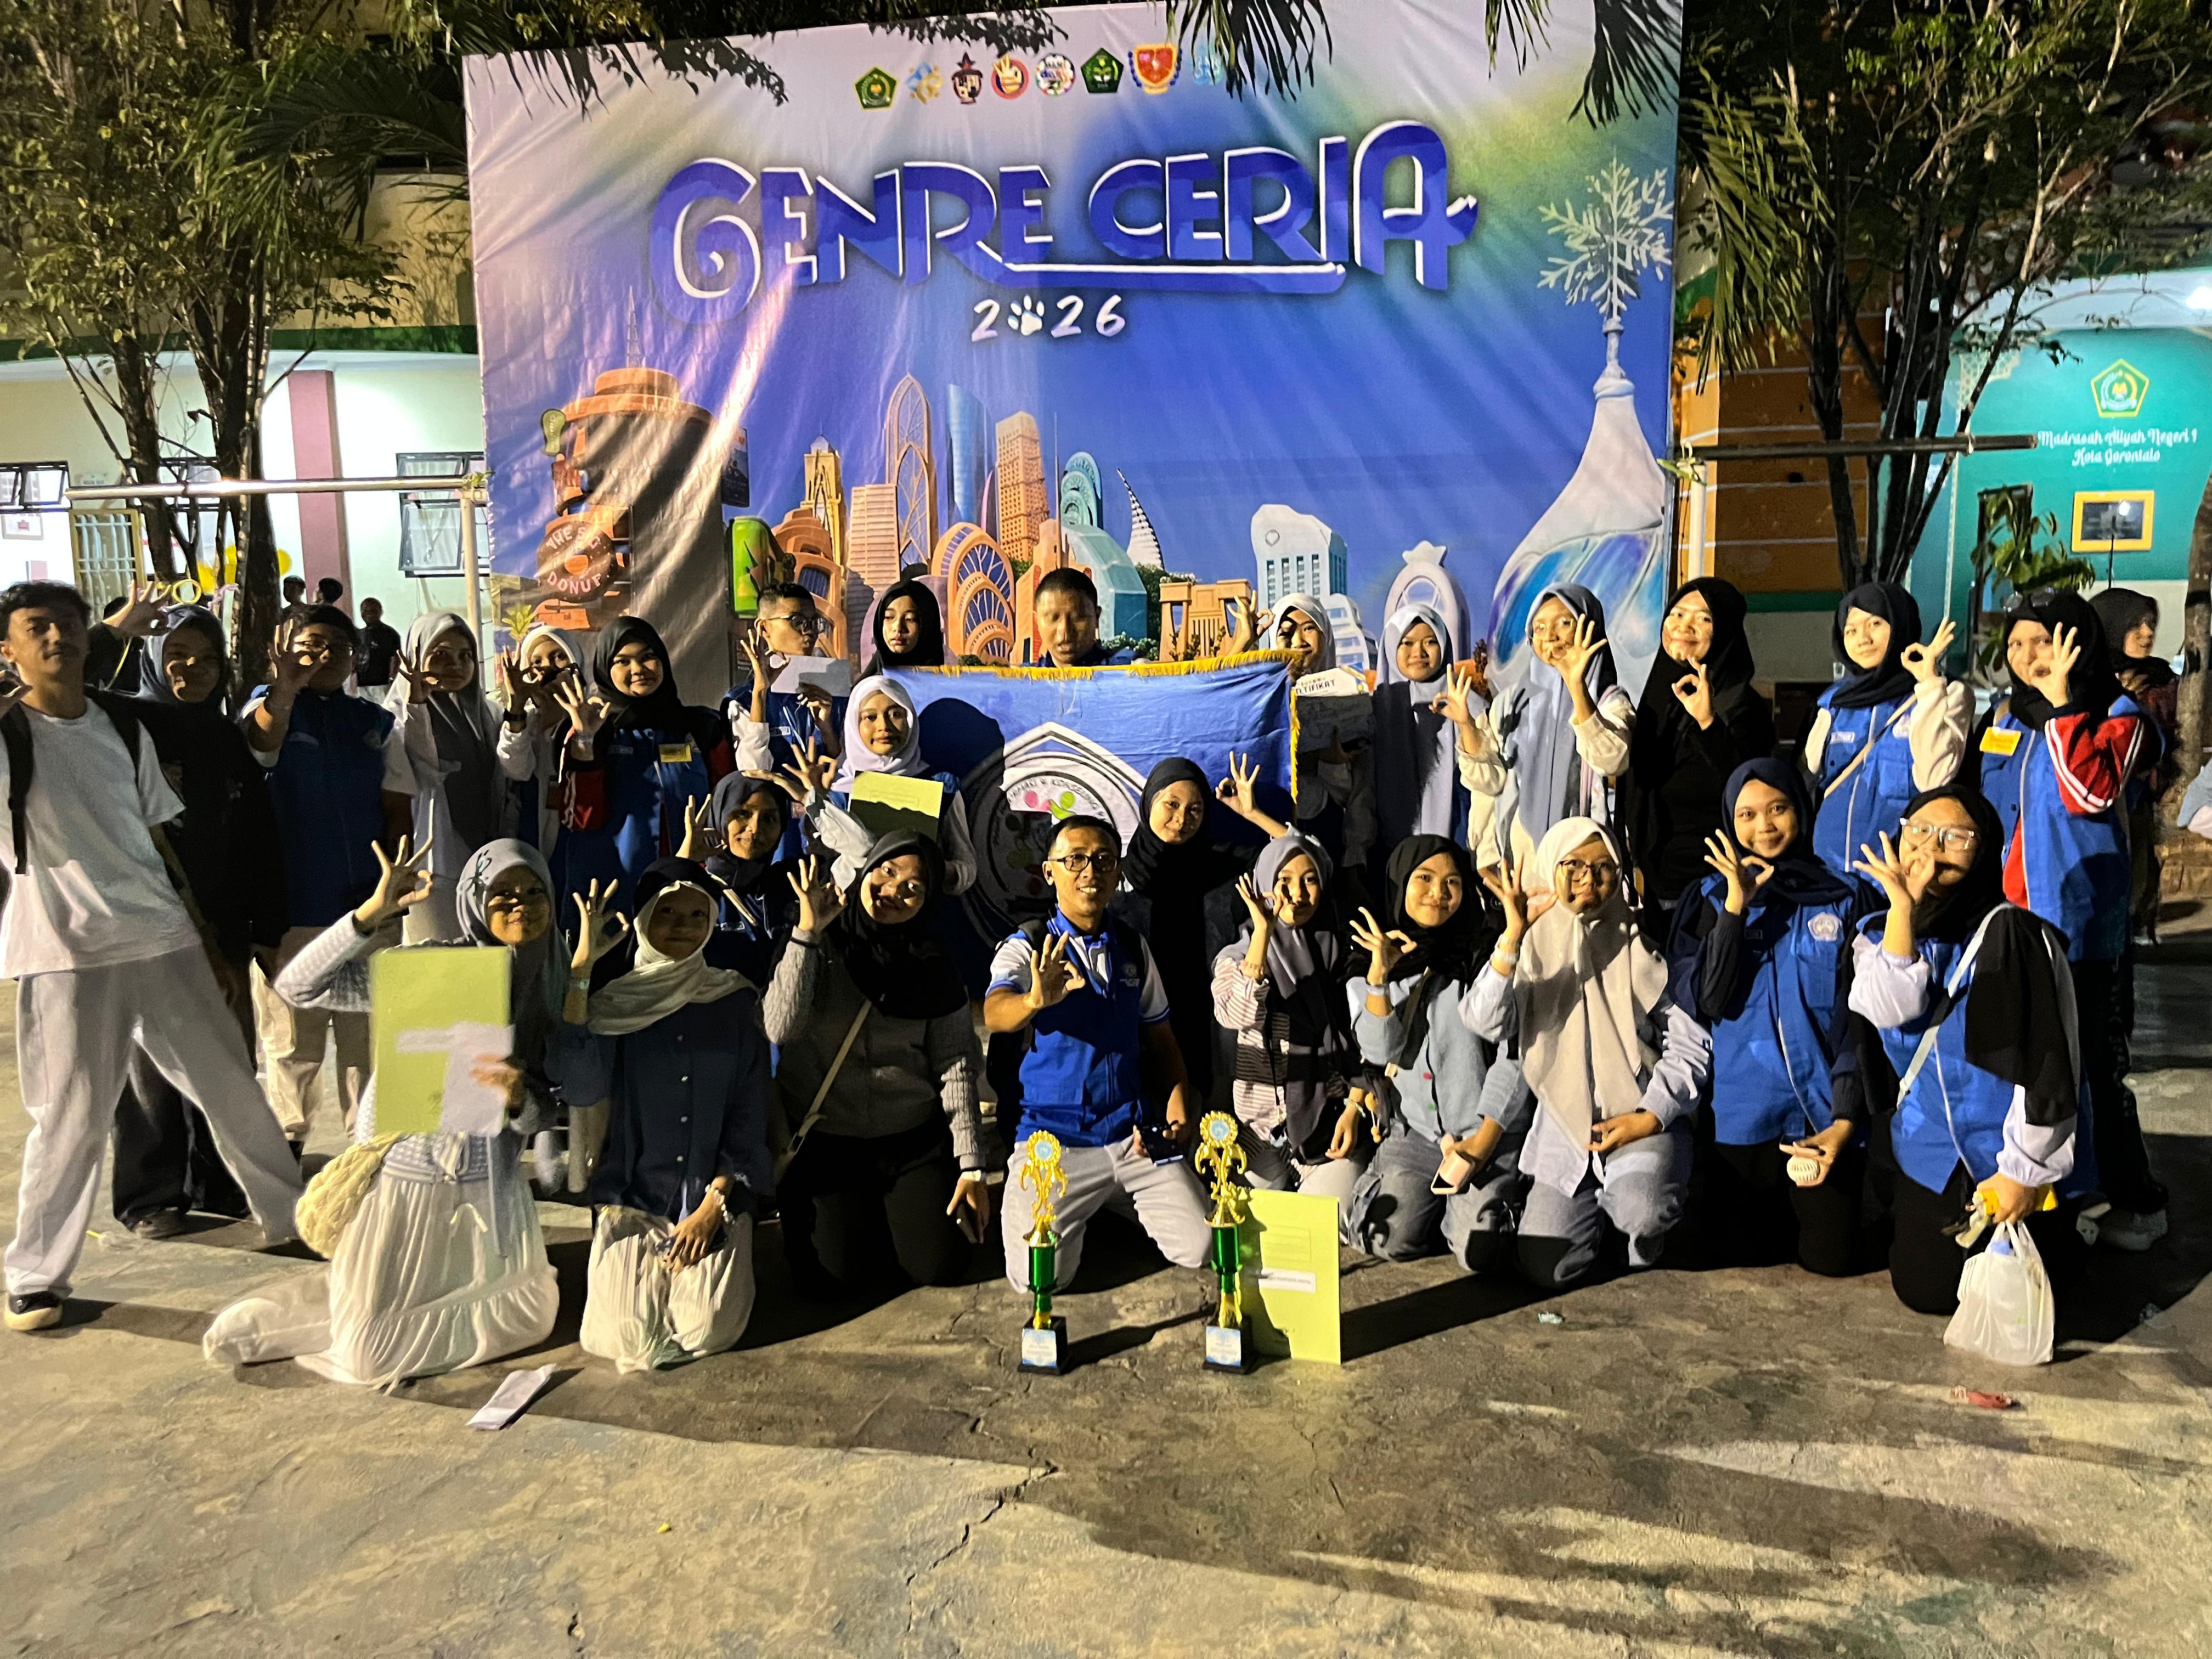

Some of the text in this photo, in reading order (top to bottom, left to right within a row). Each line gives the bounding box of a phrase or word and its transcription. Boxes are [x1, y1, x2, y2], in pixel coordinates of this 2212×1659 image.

[651, 120, 1478, 324] GENRE CERIA
[2071, 447, 2161, 467] Kota Gorontalo
